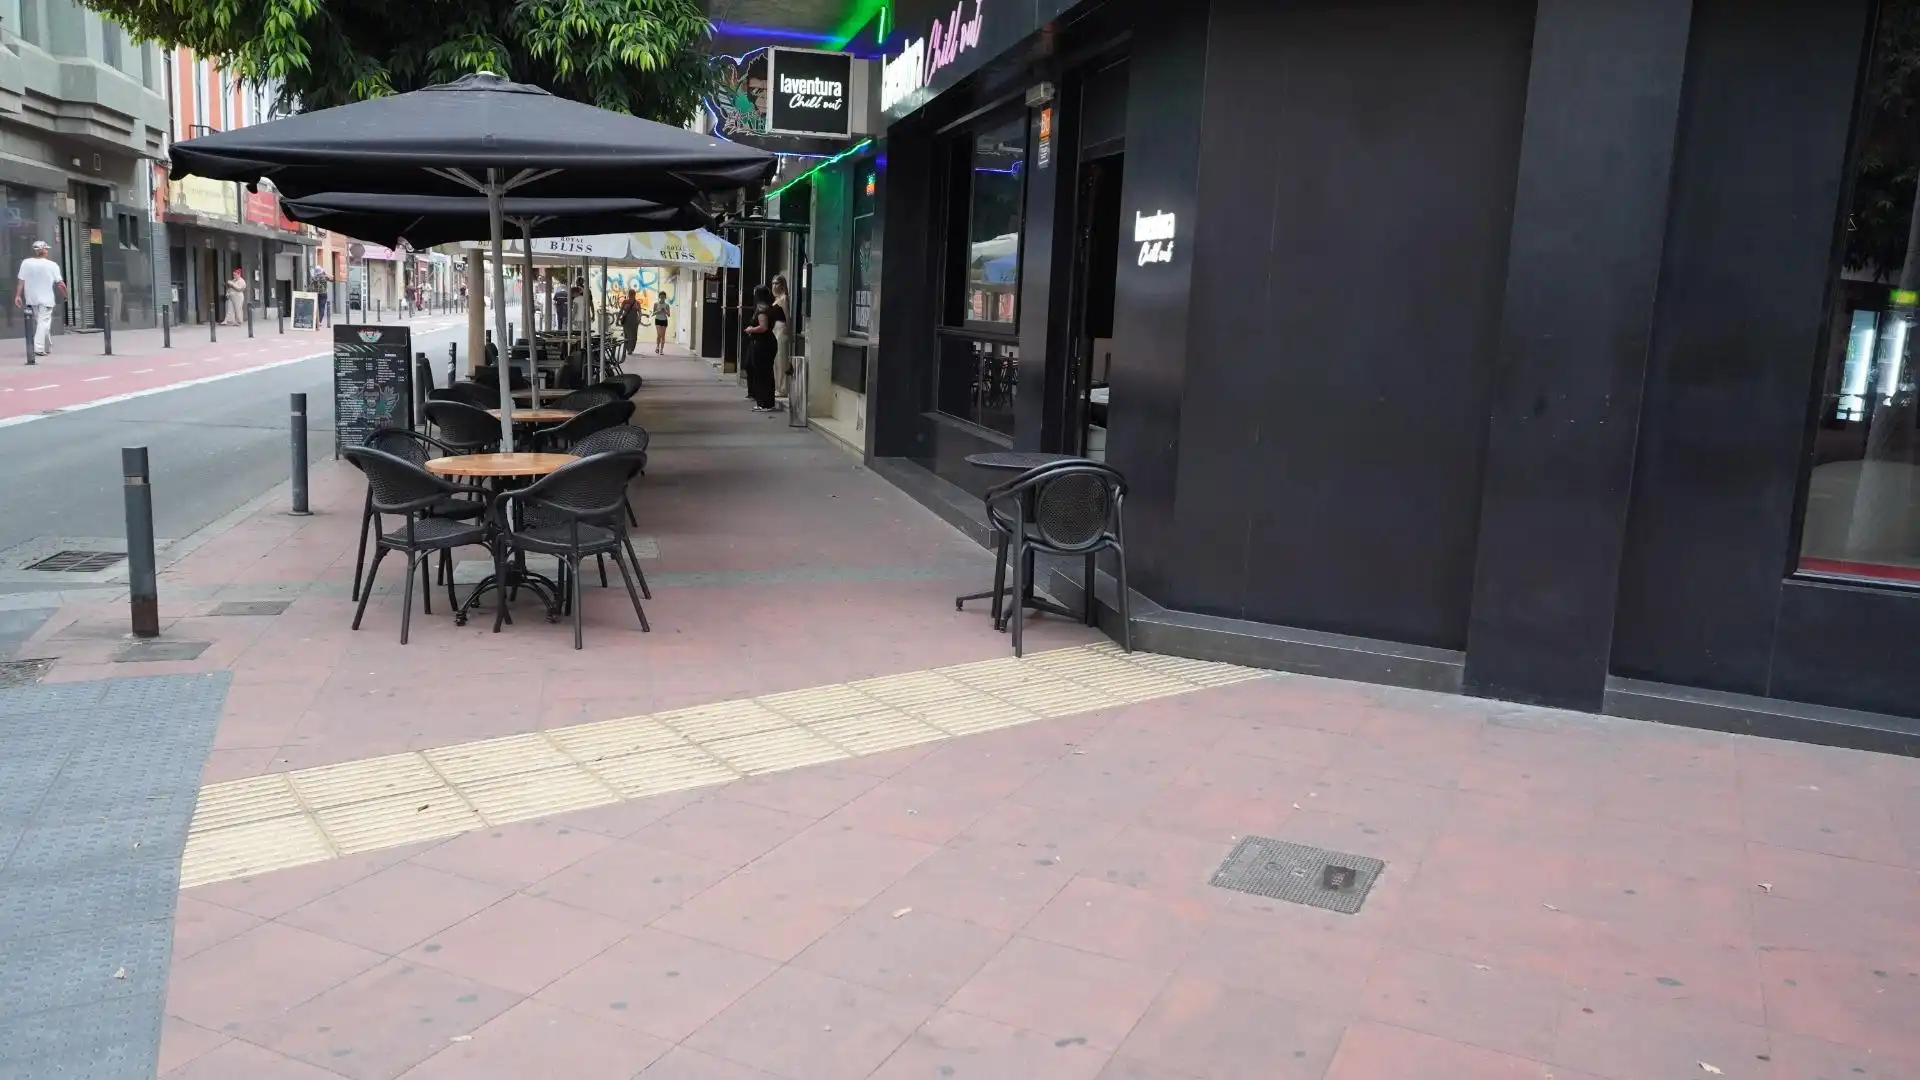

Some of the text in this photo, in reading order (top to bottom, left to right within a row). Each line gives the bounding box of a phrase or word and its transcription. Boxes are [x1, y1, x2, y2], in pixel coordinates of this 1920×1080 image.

[780, 73, 842, 97] laventura
[789, 94, 842, 111] Chill out
[550, 241, 593, 254] BLISS
[660, 250, 696, 261] BLISS
